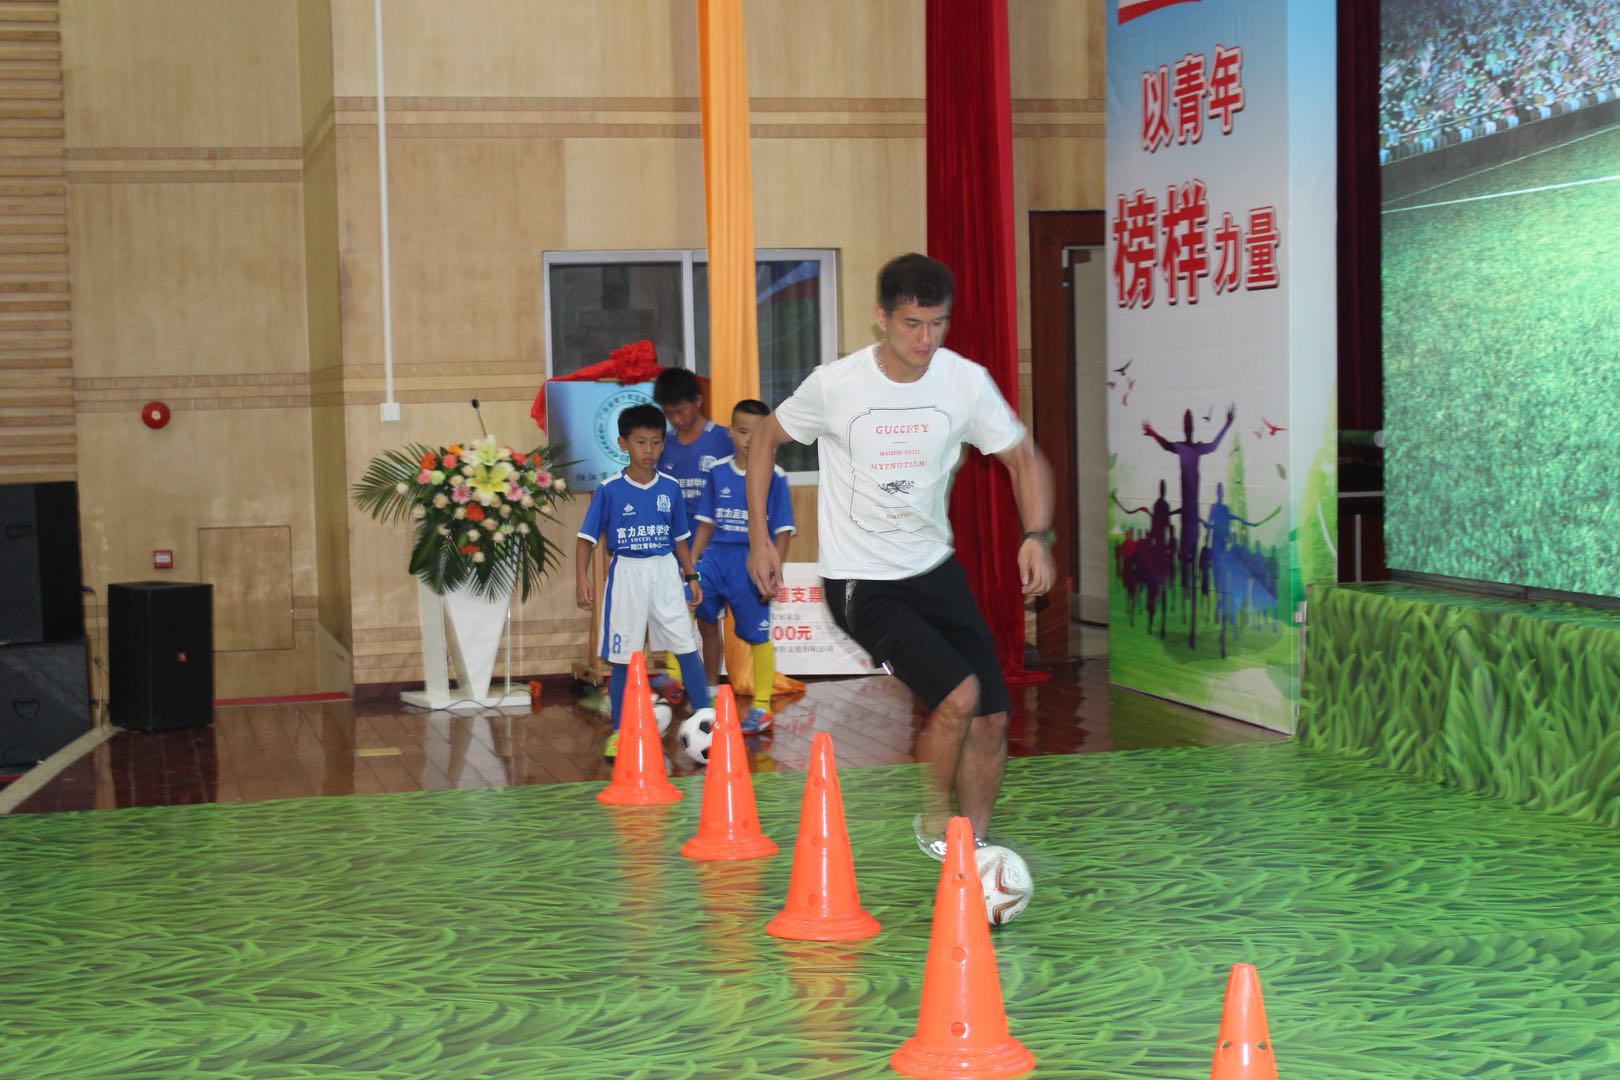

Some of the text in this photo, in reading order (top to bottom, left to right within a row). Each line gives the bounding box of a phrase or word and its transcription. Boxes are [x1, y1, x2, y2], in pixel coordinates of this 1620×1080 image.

[1140, 44, 1245, 153] 以青年
[1113, 178, 1280, 309] 榜样力量
[616, 524, 671, 539] 富力足球学校
[612, 633, 622, 654] 8
